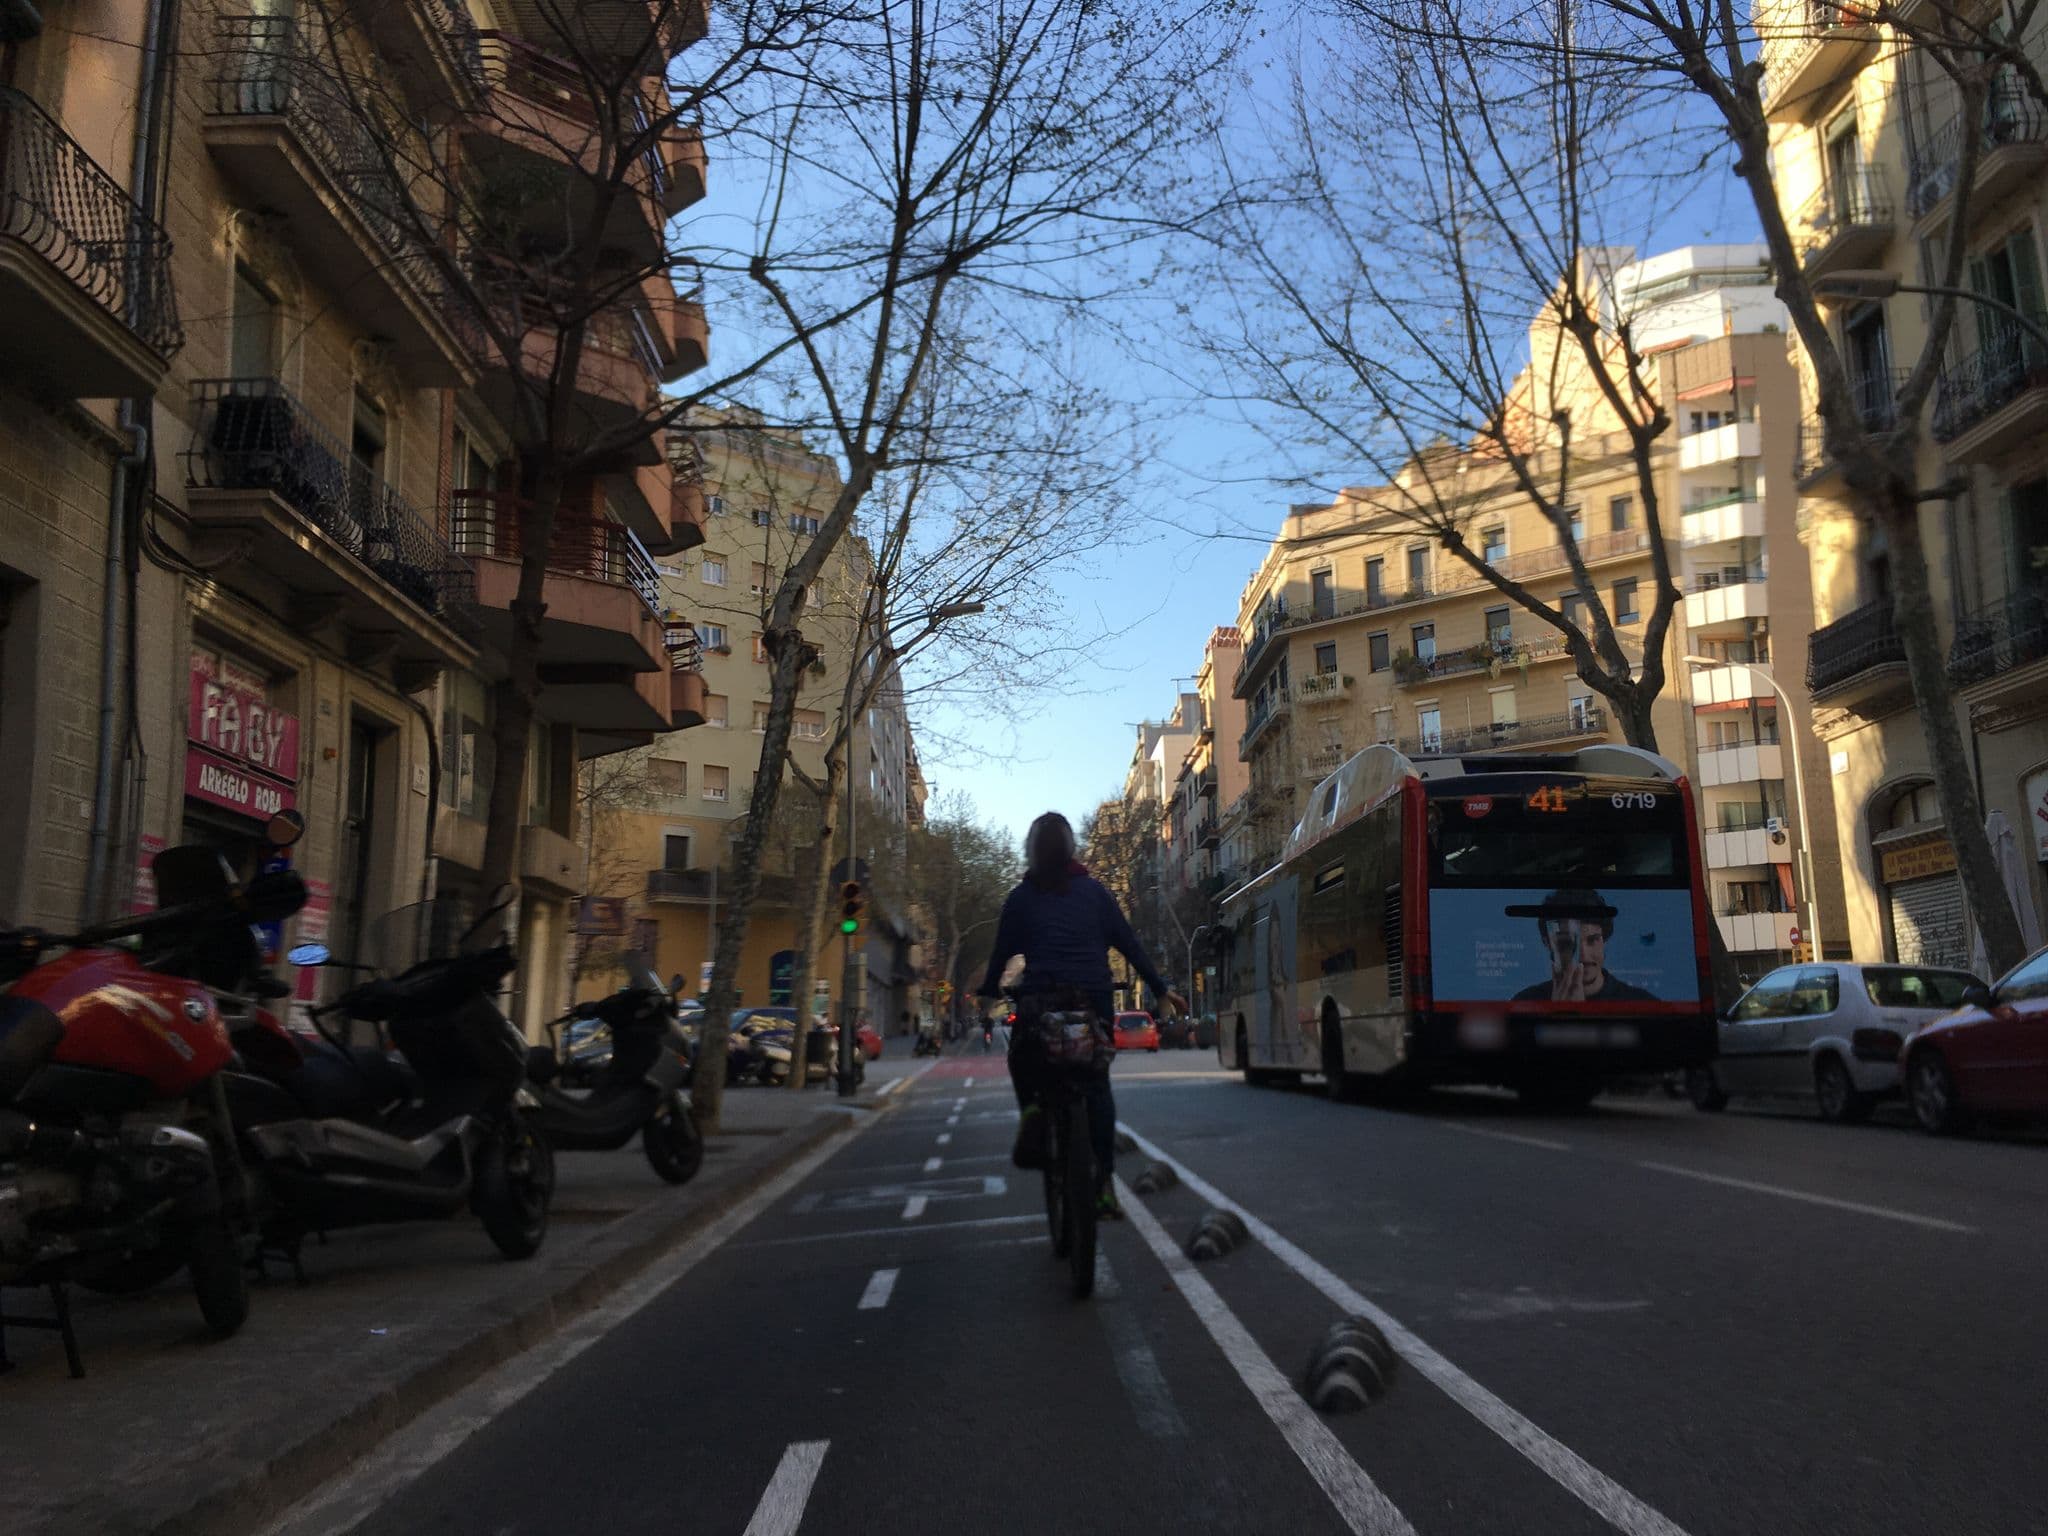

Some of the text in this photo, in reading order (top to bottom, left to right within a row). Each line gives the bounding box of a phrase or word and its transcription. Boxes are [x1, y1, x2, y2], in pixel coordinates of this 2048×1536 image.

[201, 681, 283, 768] FABY
[198, 763, 282, 814] ARREGLO ROBA
[1528, 784, 1568, 813] 41
[1610, 792, 1656, 809] 6719
[1467, 801, 1489, 812] TMB
